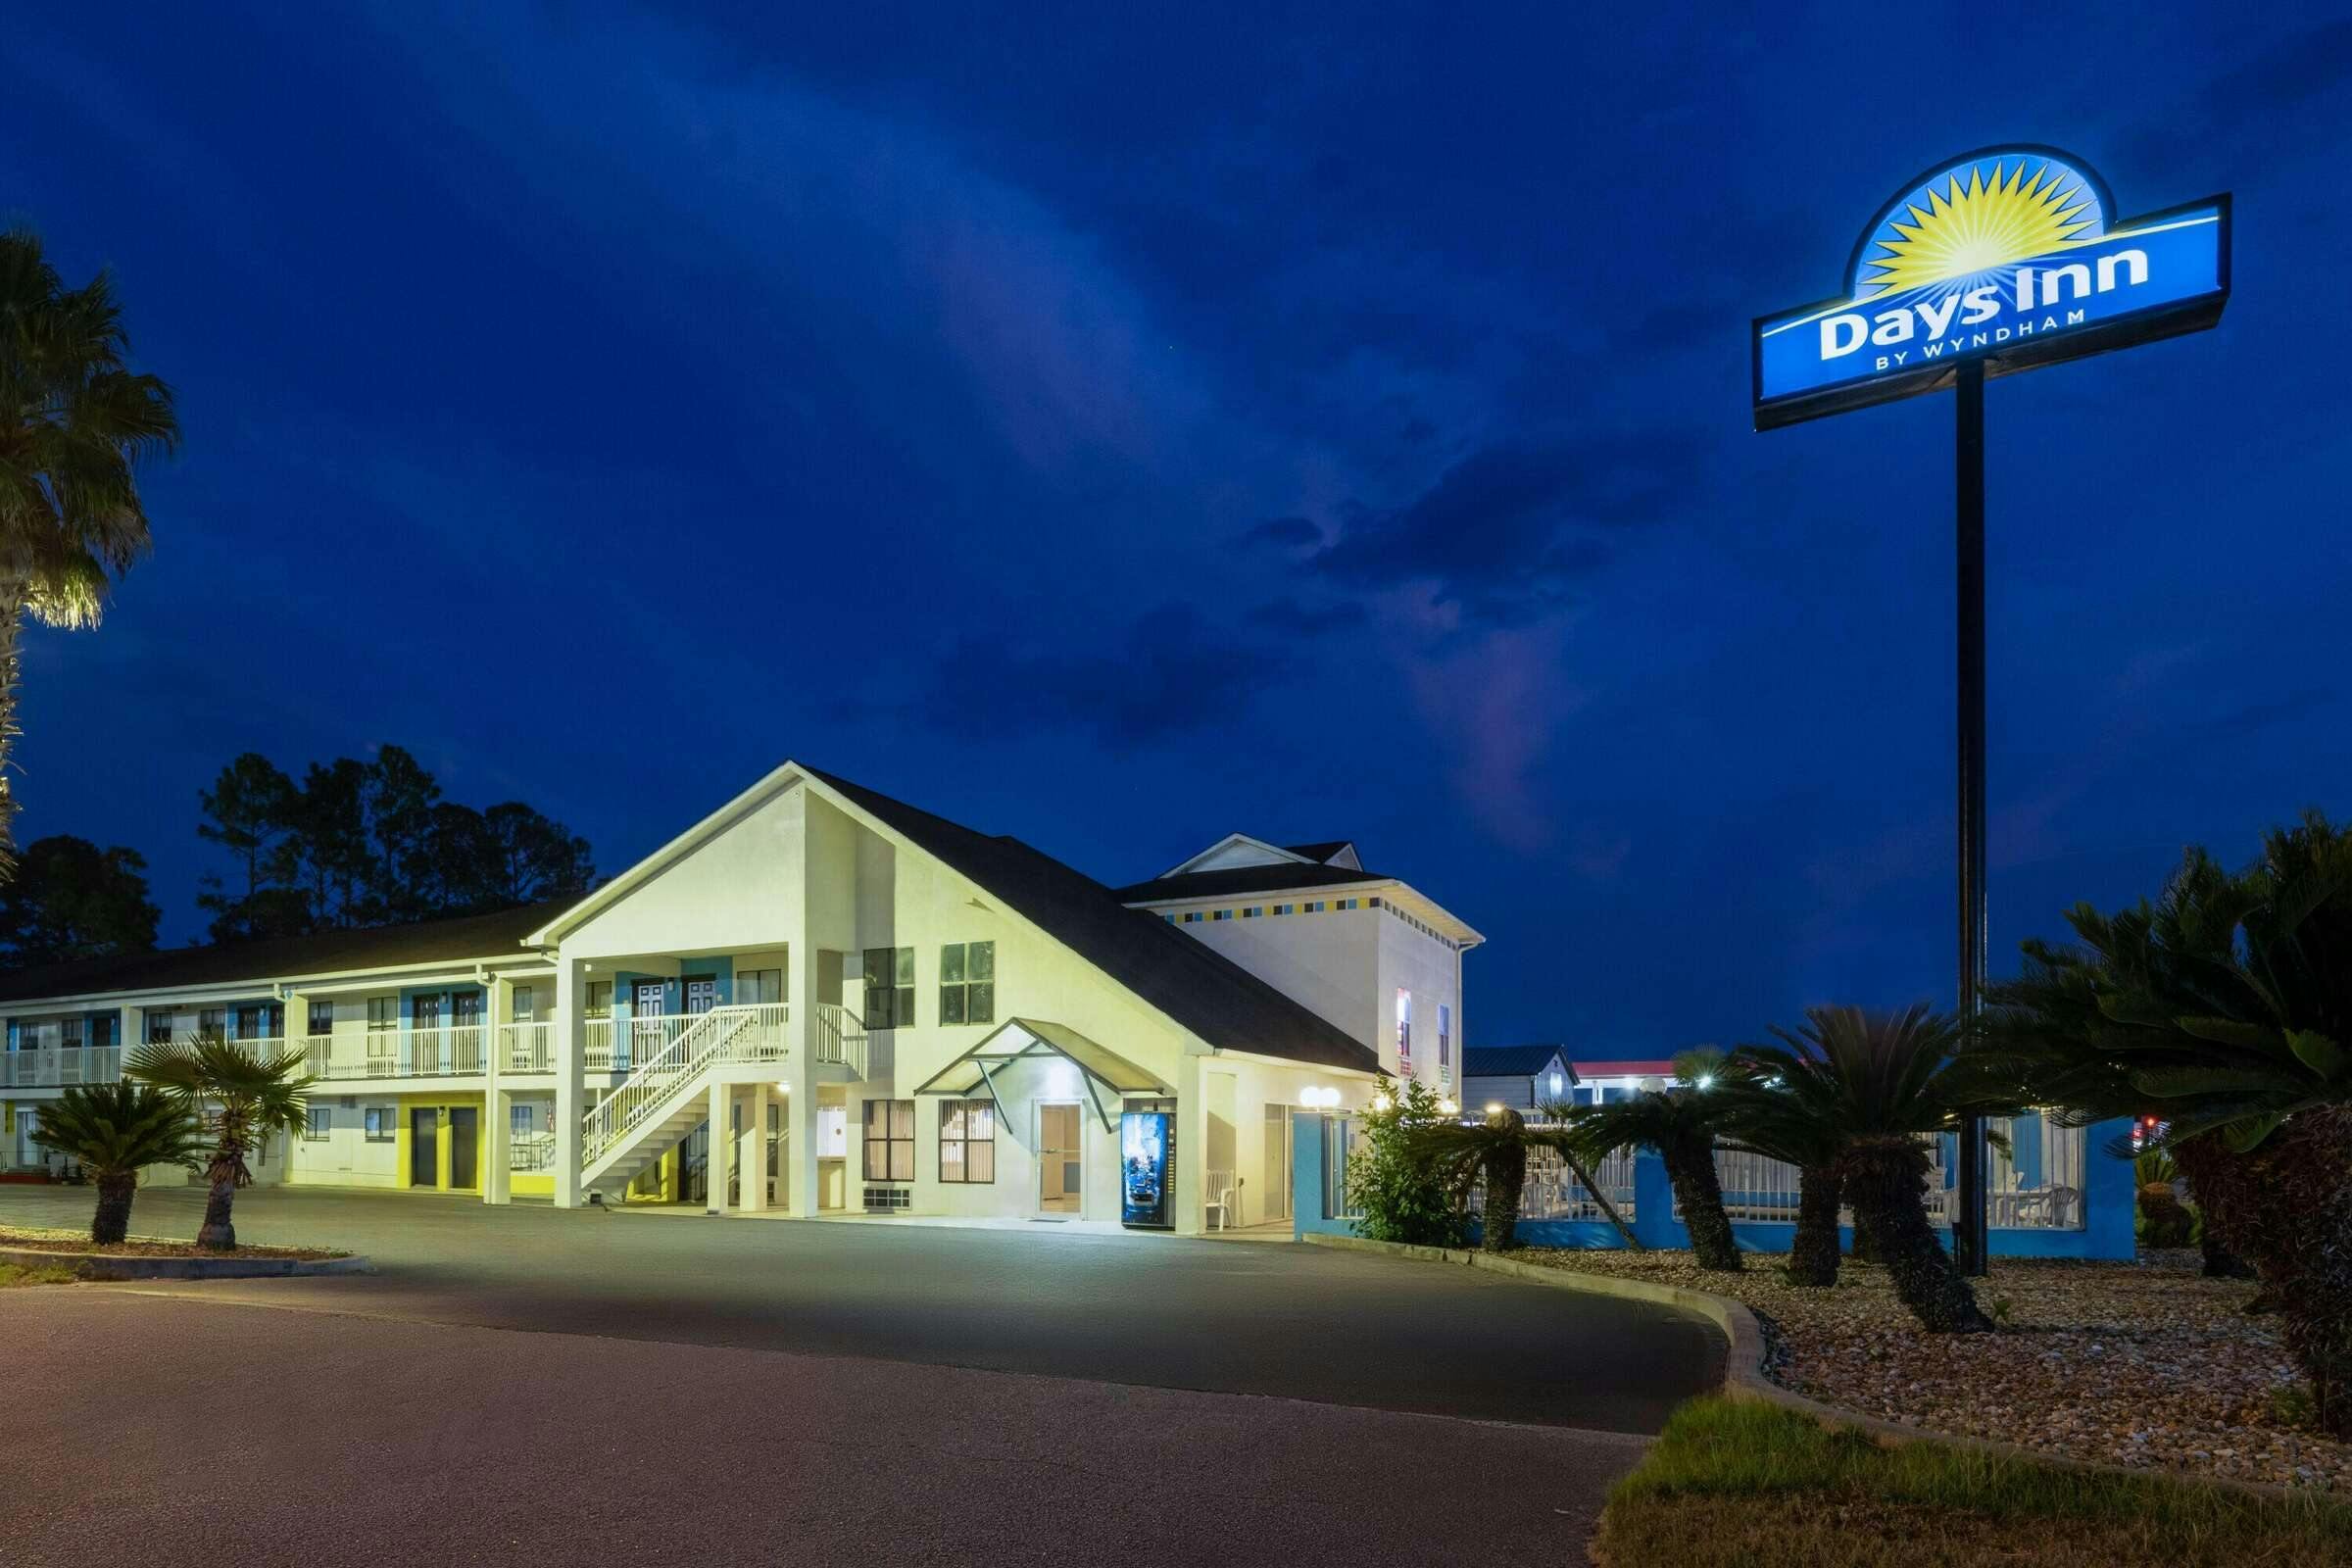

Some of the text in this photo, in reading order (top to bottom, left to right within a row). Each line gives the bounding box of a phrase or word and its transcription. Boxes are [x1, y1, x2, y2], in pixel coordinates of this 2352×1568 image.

[1821, 248, 2148, 361] Days Inn
[1876, 308, 2085, 370] BY WYNDHAM
